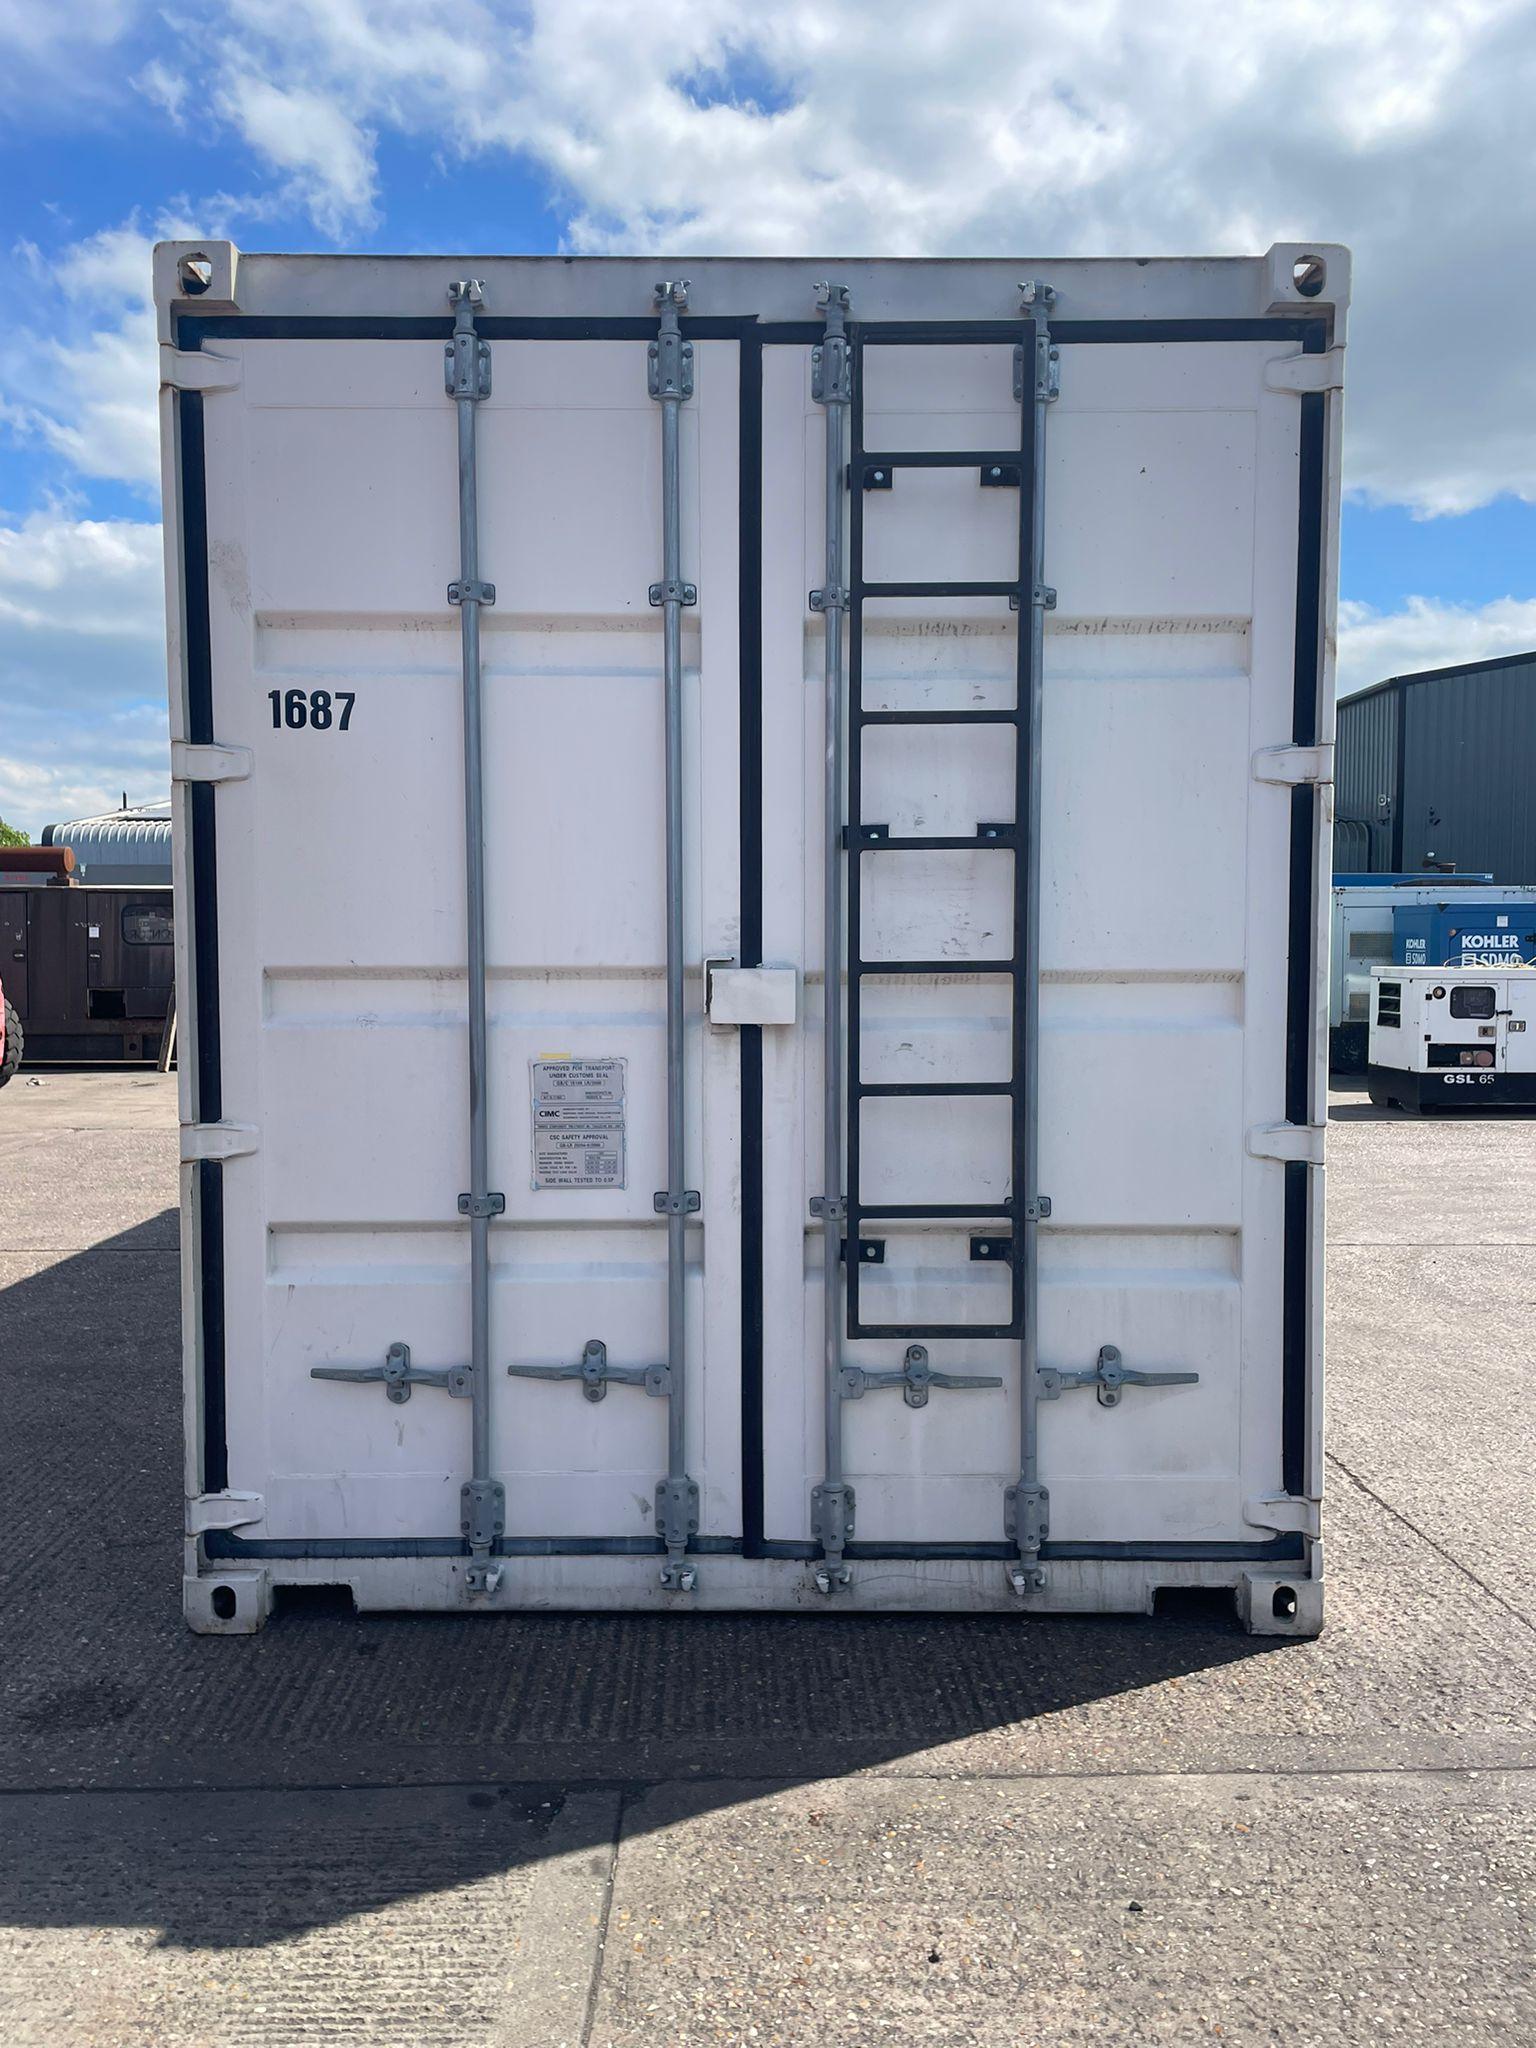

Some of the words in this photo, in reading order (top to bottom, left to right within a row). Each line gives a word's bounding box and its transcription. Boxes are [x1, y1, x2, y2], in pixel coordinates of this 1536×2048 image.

[268, 689, 356, 731] 1687
[1405, 938, 1426, 949] KOHLER
[1461, 934, 1520, 949] KOHLER
[1443, 1074, 1475, 1084] GSL
[1479, 1074, 1494, 1084] 65
